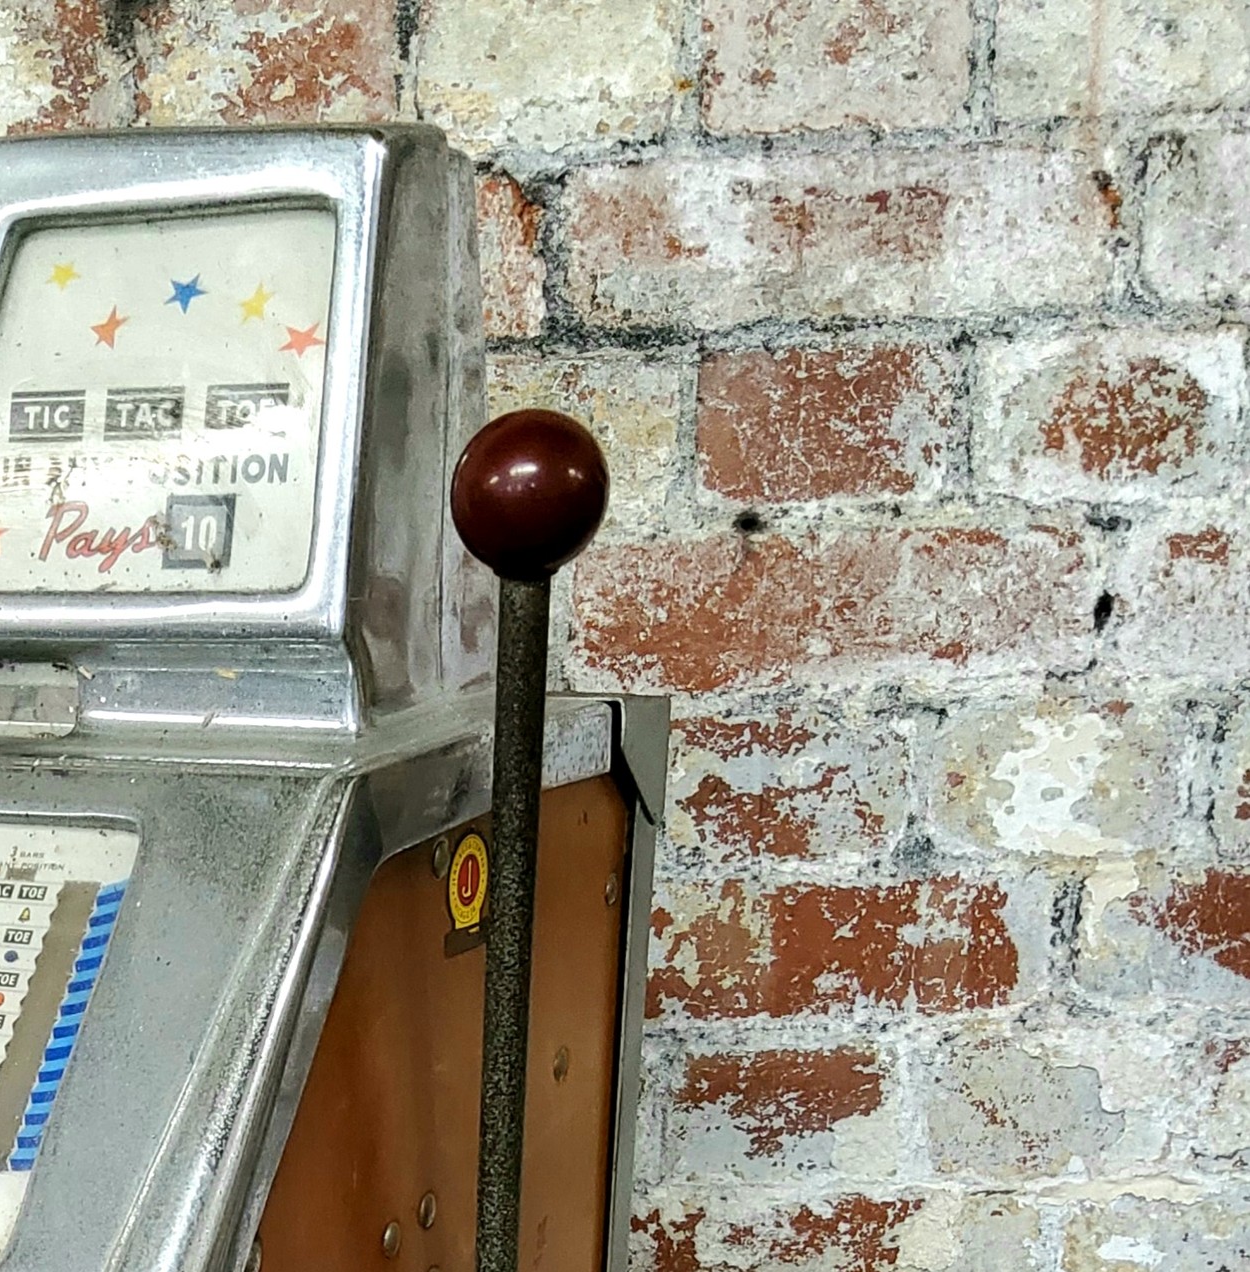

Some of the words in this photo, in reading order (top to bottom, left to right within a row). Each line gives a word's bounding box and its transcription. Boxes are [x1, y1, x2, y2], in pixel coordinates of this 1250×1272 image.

[23, 405, 70, 430] TIC
[116, 401, 176, 427] TAC
[38, 500, 158, 573] Pays
[181, 515, 217, 551] 10
[21, 887, 45, 898] TOE
[8, 931, 31, 942] TOE
